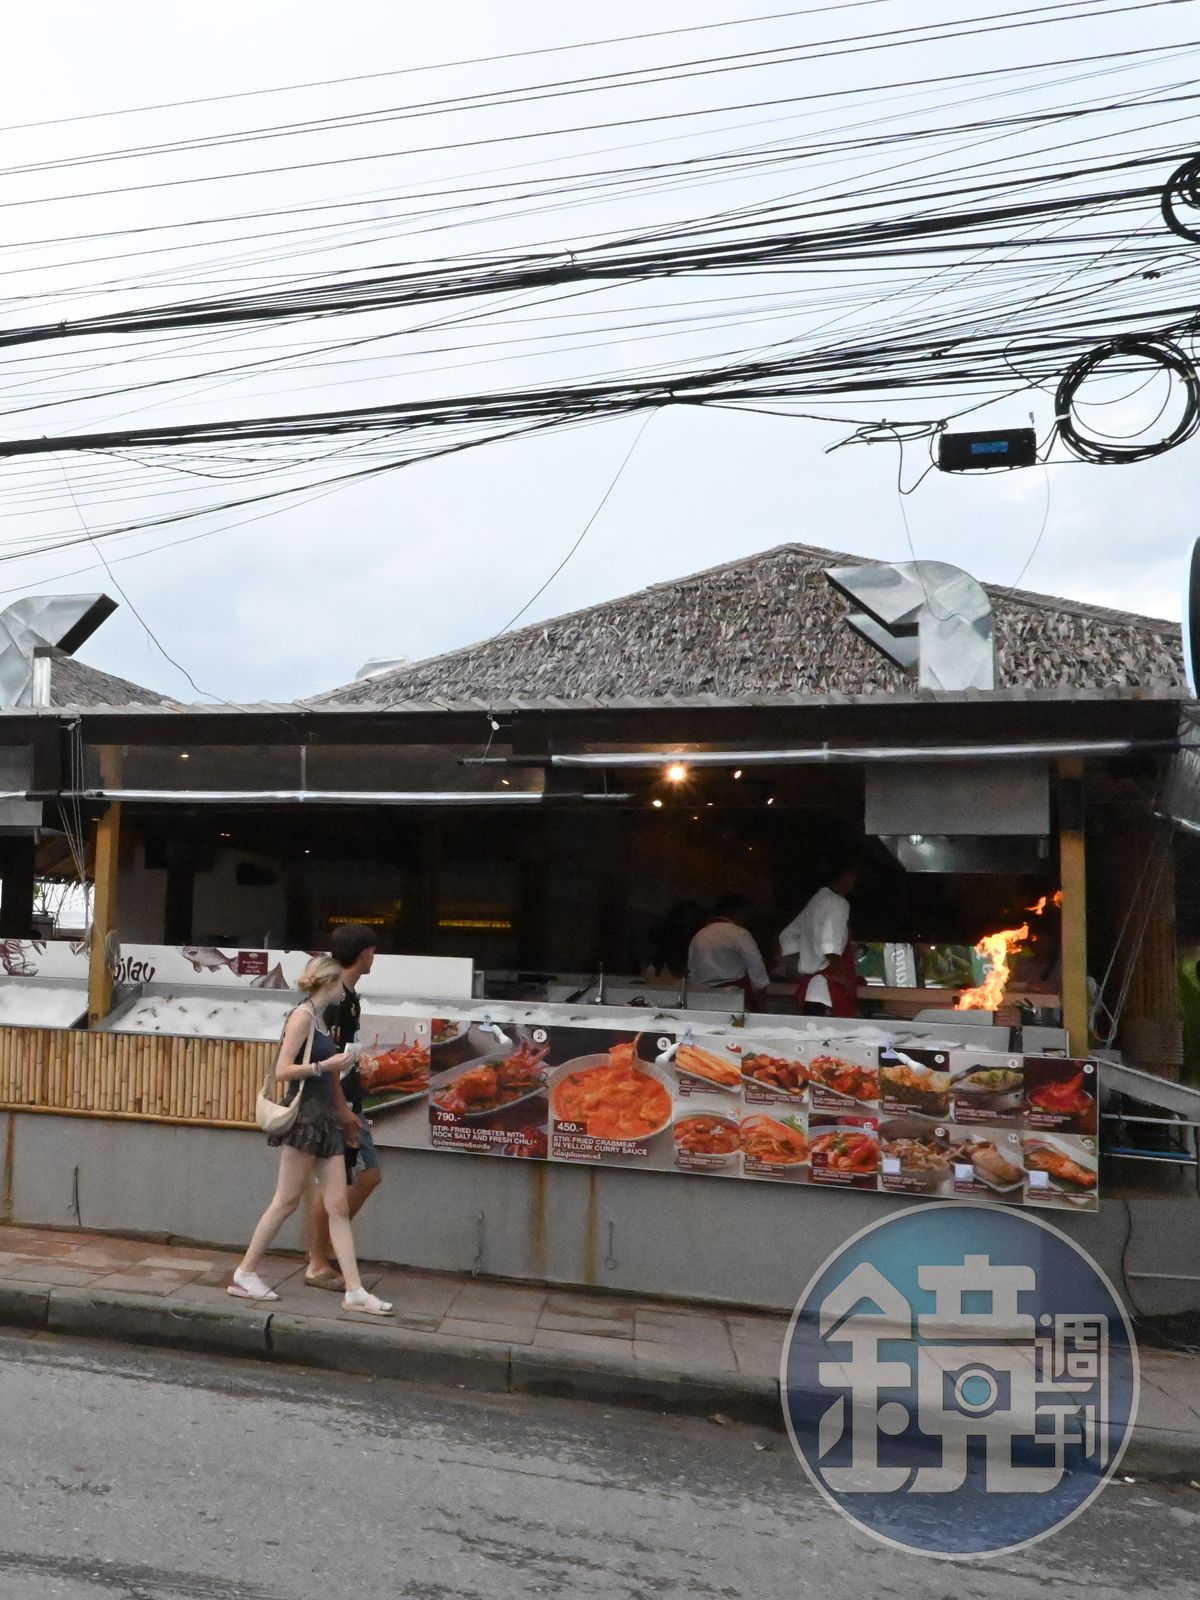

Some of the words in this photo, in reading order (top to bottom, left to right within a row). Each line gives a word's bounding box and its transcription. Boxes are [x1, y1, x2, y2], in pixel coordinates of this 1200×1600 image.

[112, 956, 156, 983] oilay
[436, 1111, 461, 1122] 790.-
[432, 1125, 471, 1134] STIR-FRIED
[472, 1128, 505, 1137] LOBSTER
[557, 1122, 583, 1132] 450.-
[562, 1142, 593, 1151] YELLOW
[594, 1144, 620, 1153] CURRY
[622, 1147, 648, 1156] SAUCE
[595, 1139, 636, 1148] CRABMEAT
